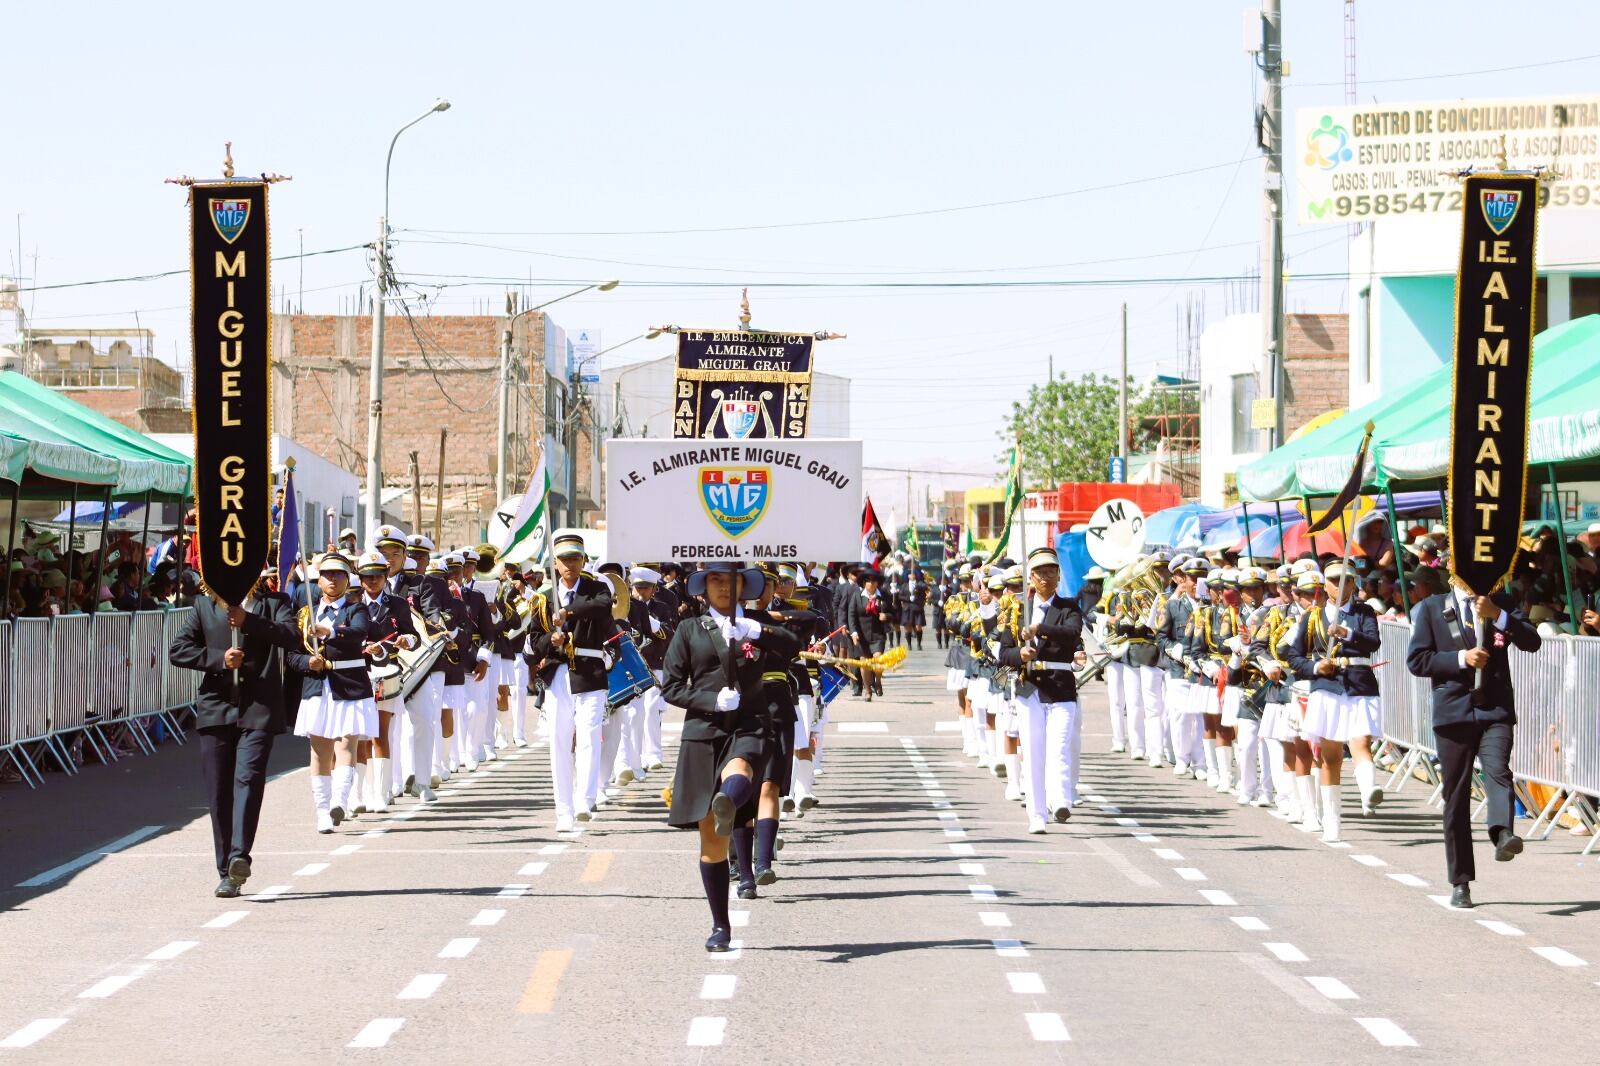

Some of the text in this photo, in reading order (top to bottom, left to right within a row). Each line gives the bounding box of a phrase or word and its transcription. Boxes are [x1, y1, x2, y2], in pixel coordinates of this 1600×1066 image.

[1352, 111, 1411, 138] CENTRO
[1414, 109, 1434, 134] DE
[1437, 104, 1547, 133] CONCILIACION
[1358, 134, 1598, 165] ESTUDIO DE ABOGADO & ASOCIADOS
[1332, 172, 1368, 191] CASOS:
[1371, 170, 1398, 189] CIVIL
[1406, 168, 1439, 188] PENAL
[1478, 240, 1517, 263] I.E.
[215, 250, 246, 427] MIGUEL
[687, 332, 805, 345] I.E. EMBLEMATICA
[705, 345, 784, 357] ALMIRANTE
[698, 359, 791, 372] MIGUEL GRAU
[674, 381, 694, 438] BAN
[1473, 271, 1510, 562] ALMIRANTE
[620, 447, 850, 492] I.E. ALMIRANTE MIGUEL GRAU
[219, 455, 246, 566] GRAU
[671, 545, 741, 558] PEDREGAL
[753, 545, 797, 558] MAJES
